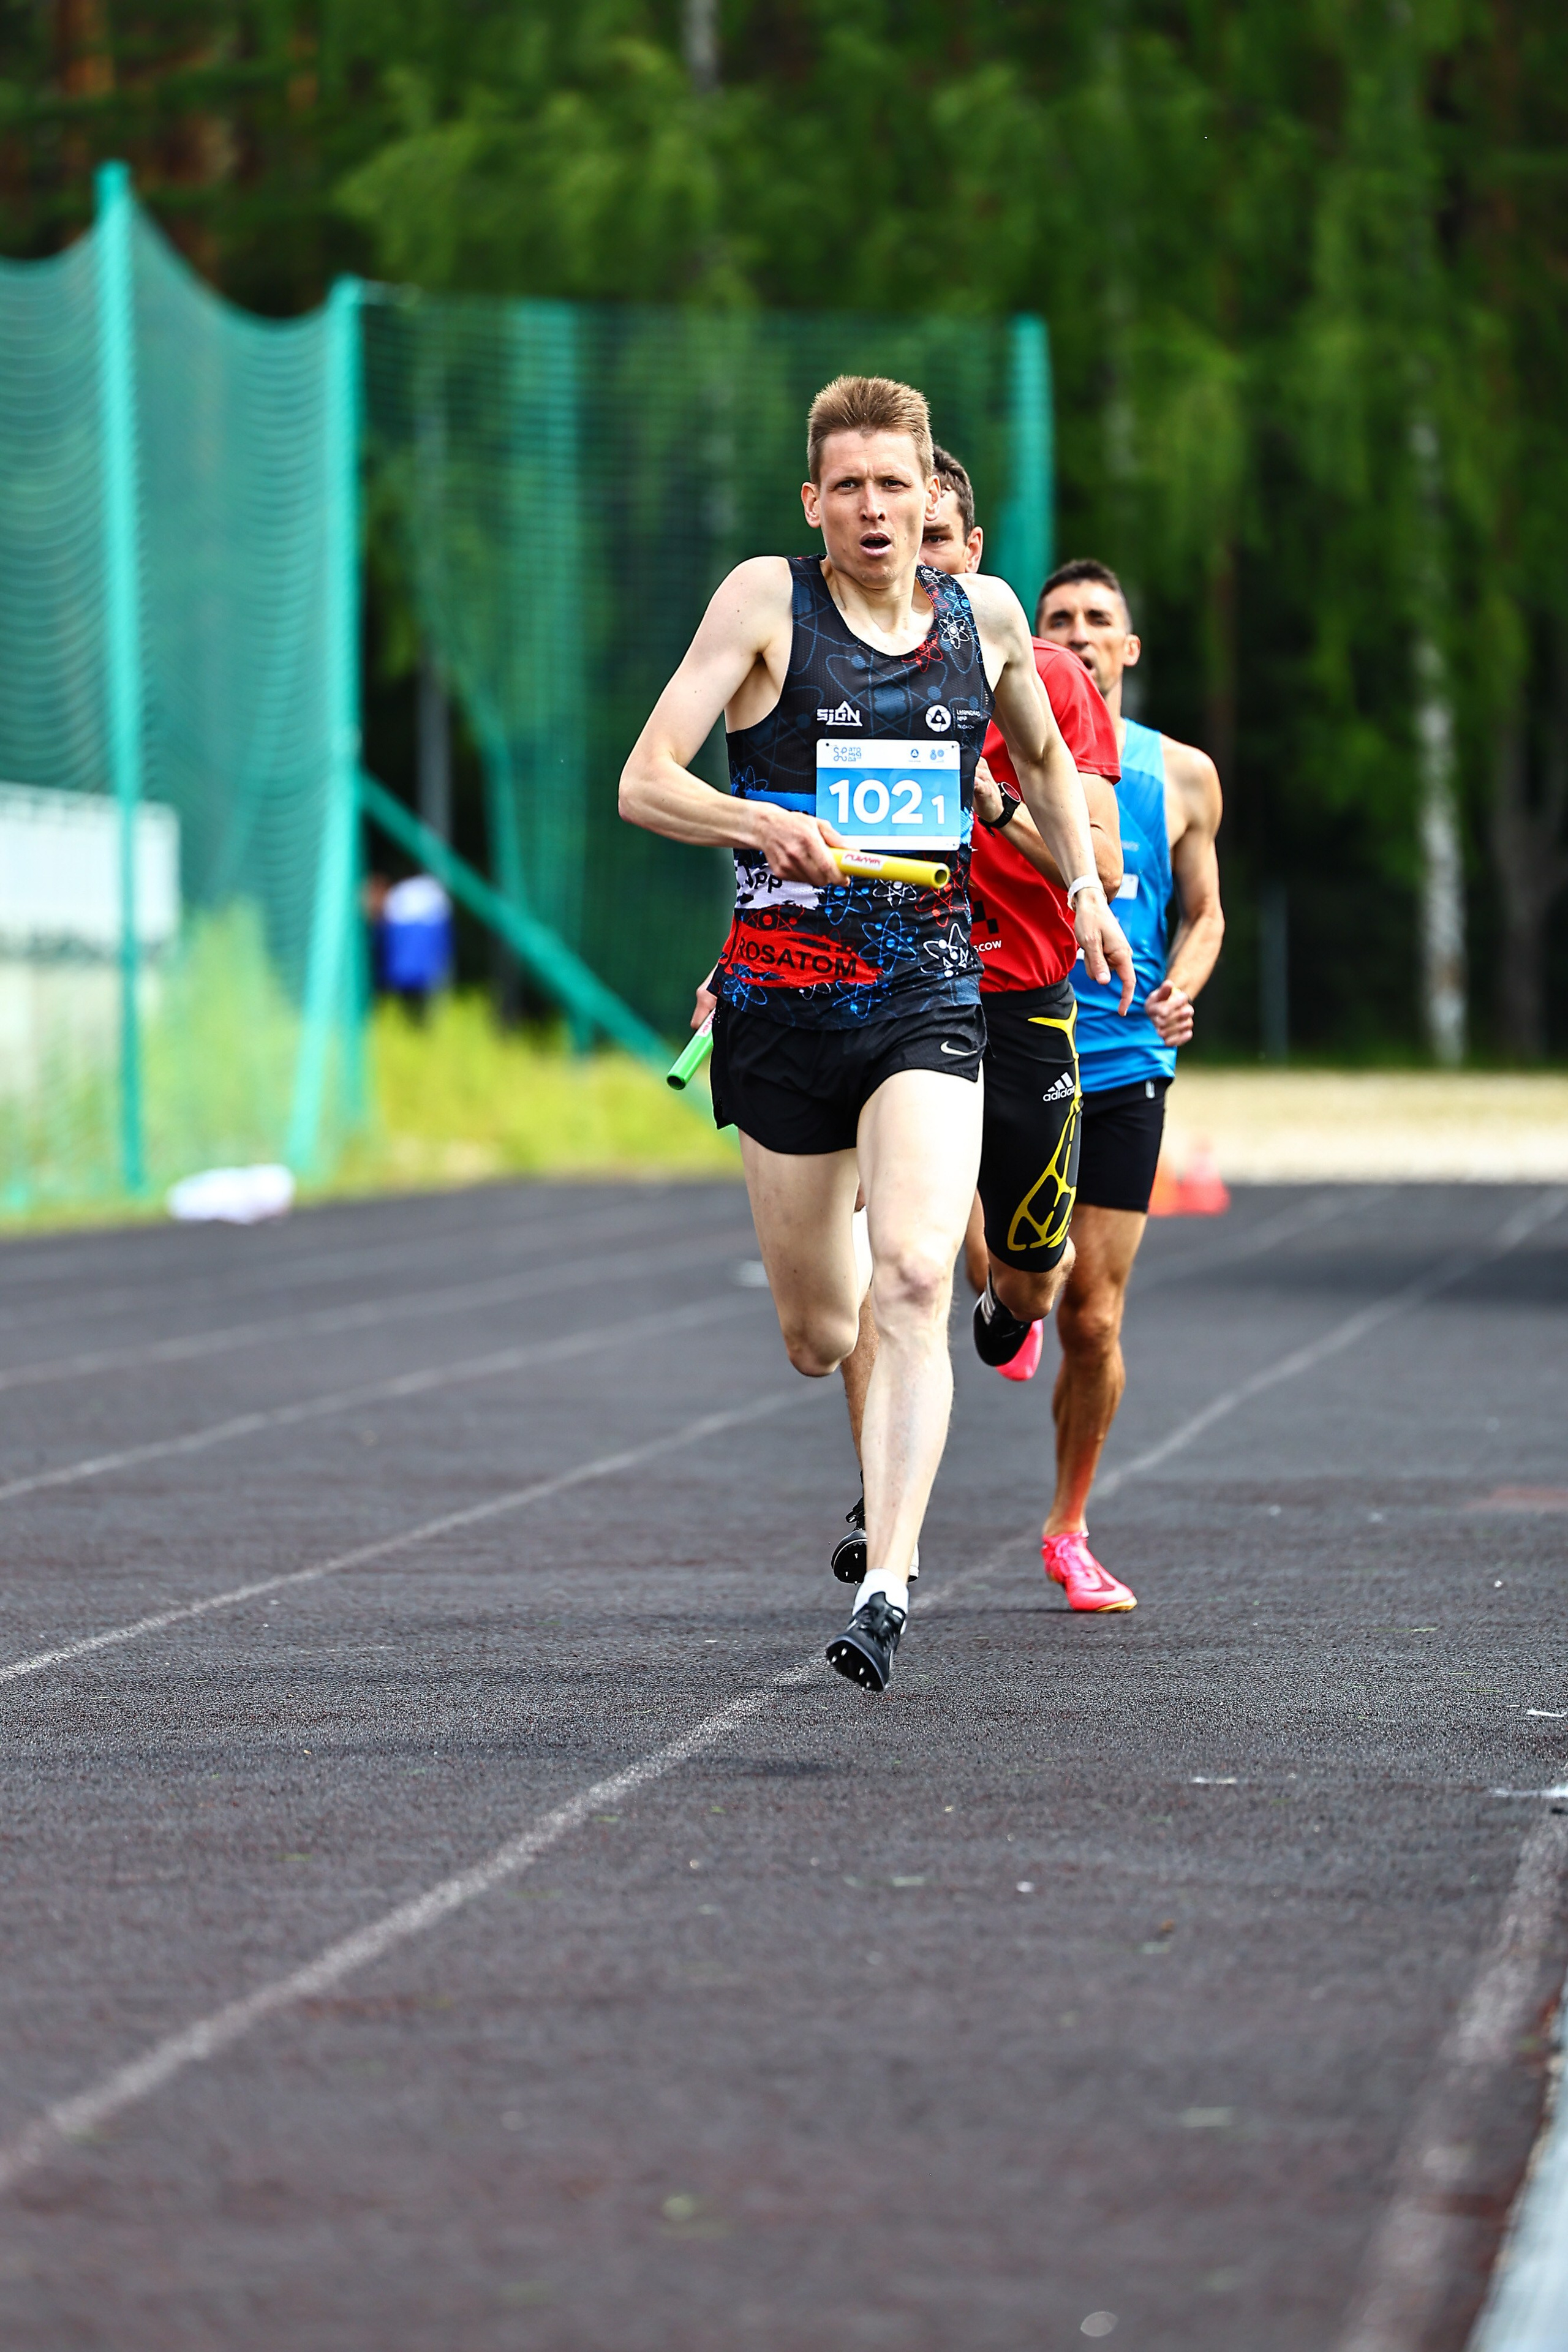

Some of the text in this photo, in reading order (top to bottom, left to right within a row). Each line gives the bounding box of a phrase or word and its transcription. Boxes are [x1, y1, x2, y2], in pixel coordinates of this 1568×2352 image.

[828, 778, 945, 825] 102 1
[737, 937, 857, 977] ROSATOM
